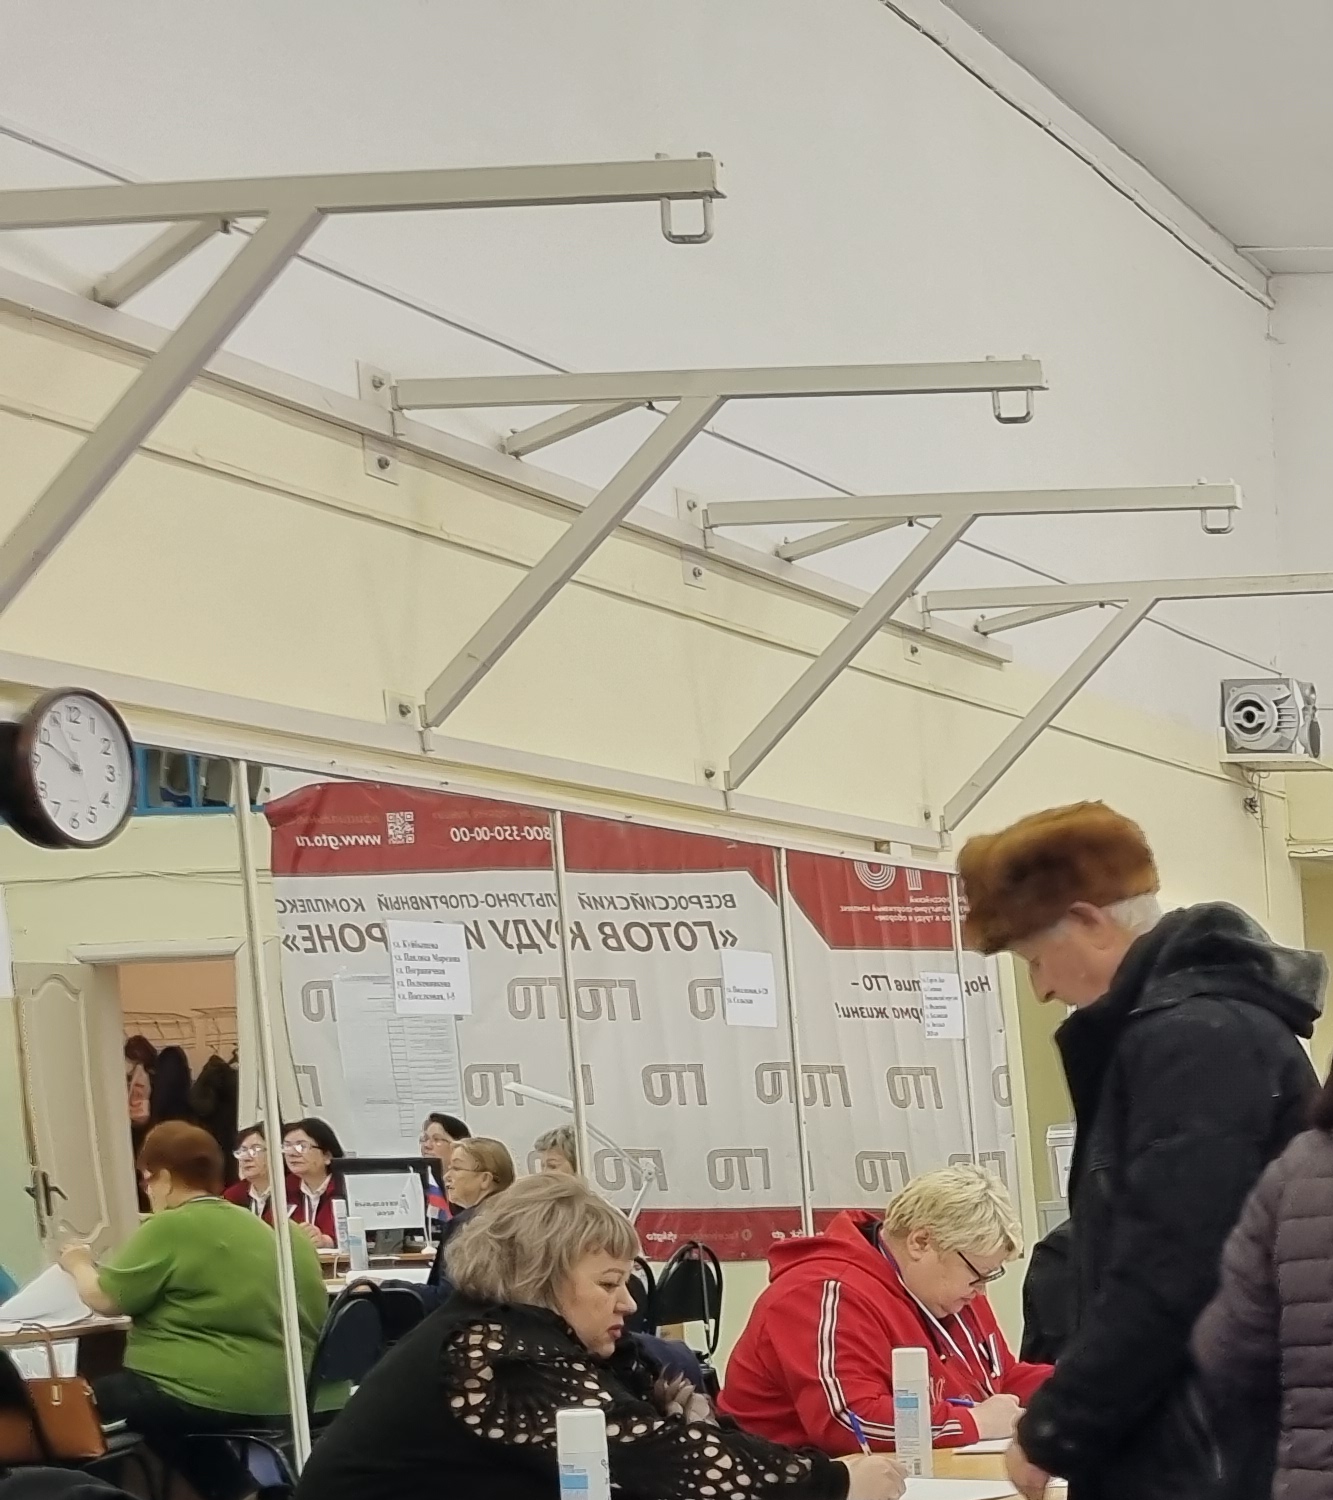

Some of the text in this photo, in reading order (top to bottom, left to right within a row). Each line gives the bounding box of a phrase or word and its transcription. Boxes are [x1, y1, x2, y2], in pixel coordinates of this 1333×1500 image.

[65, 704, 81, 725] 12
[100, 738, 112, 756] 2
[105, 764, 116, 783] 3
